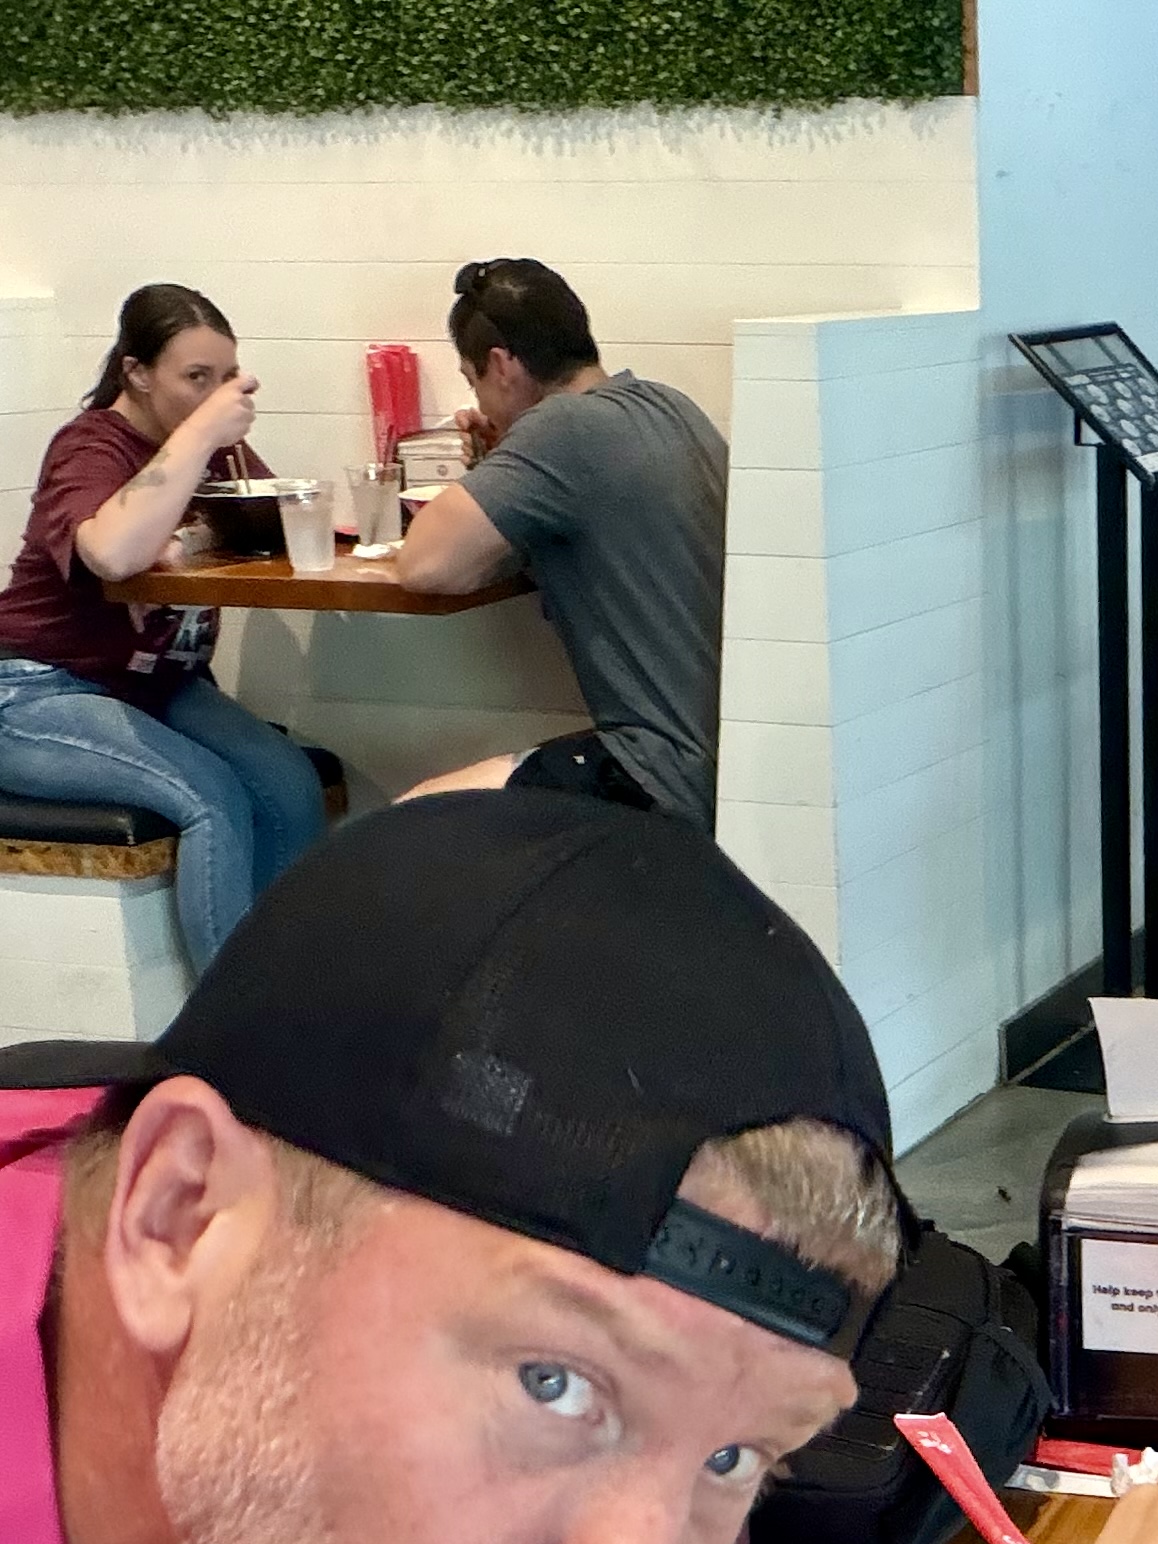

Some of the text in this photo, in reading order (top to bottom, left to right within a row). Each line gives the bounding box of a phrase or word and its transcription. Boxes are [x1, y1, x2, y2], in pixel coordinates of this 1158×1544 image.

[1092, 1284, 1121, 1298] Help
[1123, 1286, 1154, 1300] keep
[1111, 1302, 1135, 1312] and
